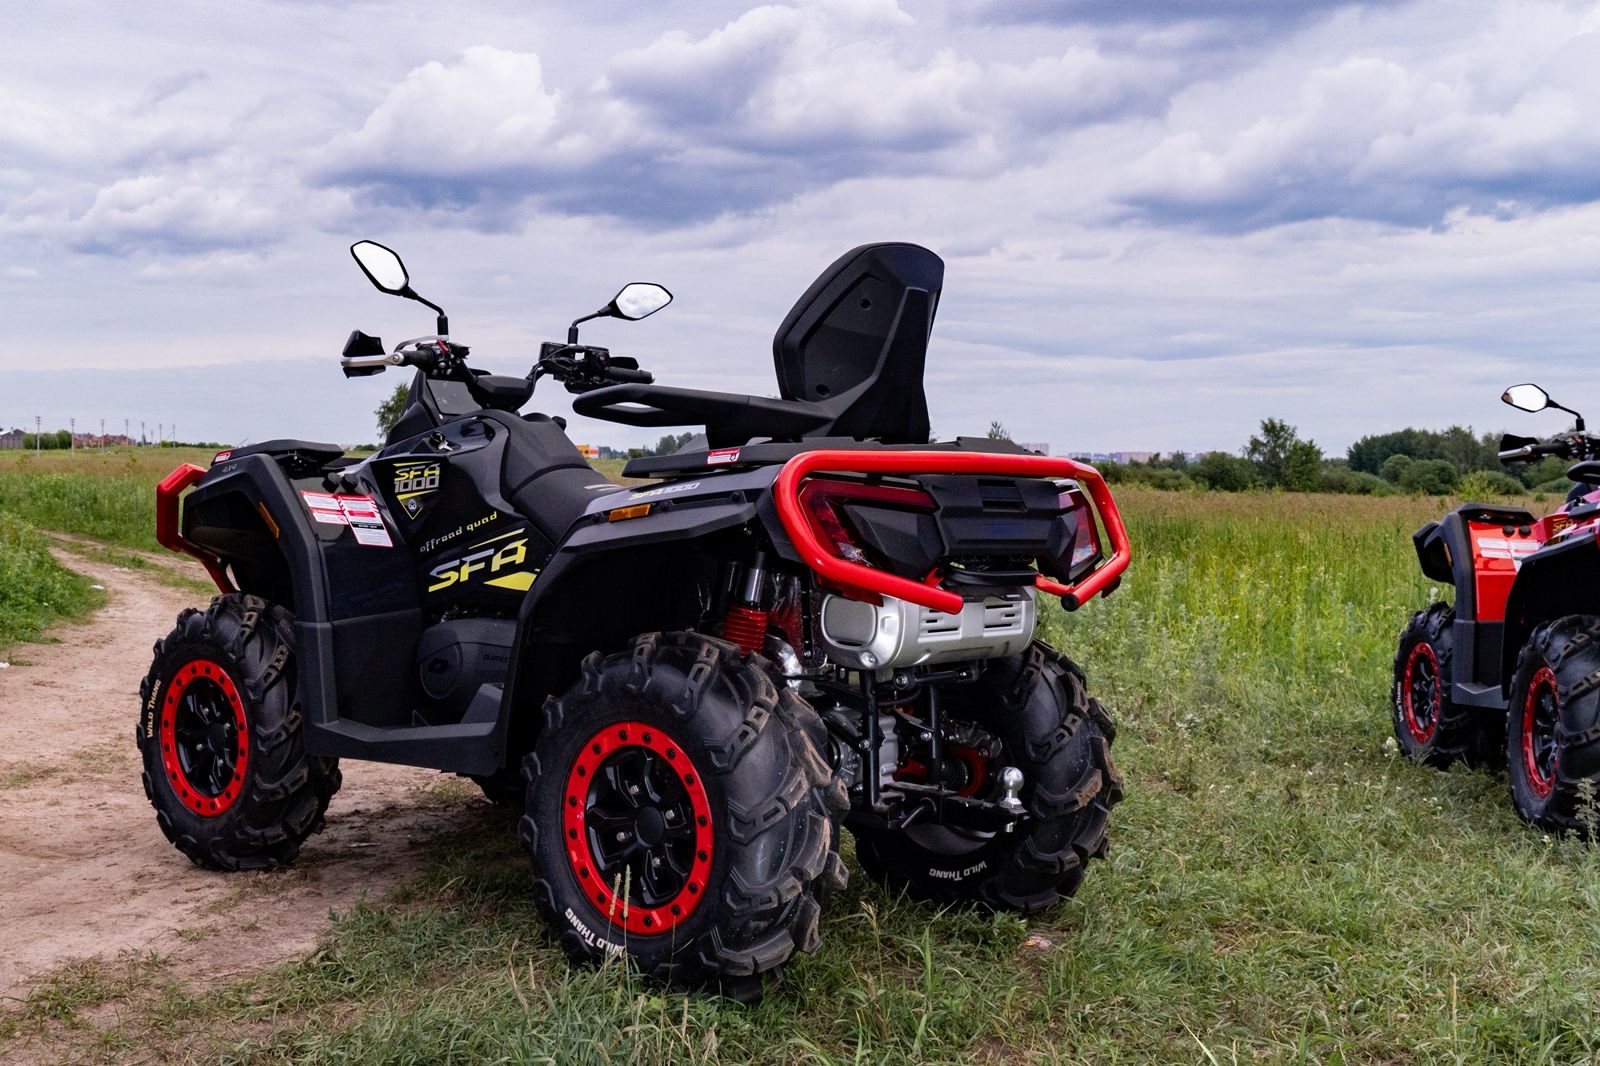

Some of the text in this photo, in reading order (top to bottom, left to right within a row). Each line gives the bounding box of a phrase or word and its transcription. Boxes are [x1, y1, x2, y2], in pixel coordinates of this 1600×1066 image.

[393, 463, 441, 481] SFA
[394, 476, 440, 493] 1000
[664, 482, 701, 494] 1000
[420, 511, 498, 552] offroad quad
[428, 538, 529, 593] SFA
[147, 679, 162, 710] THANG
[928, 860, 988, 881] WILD THANG
[564, 907, 596, 947] THANG
